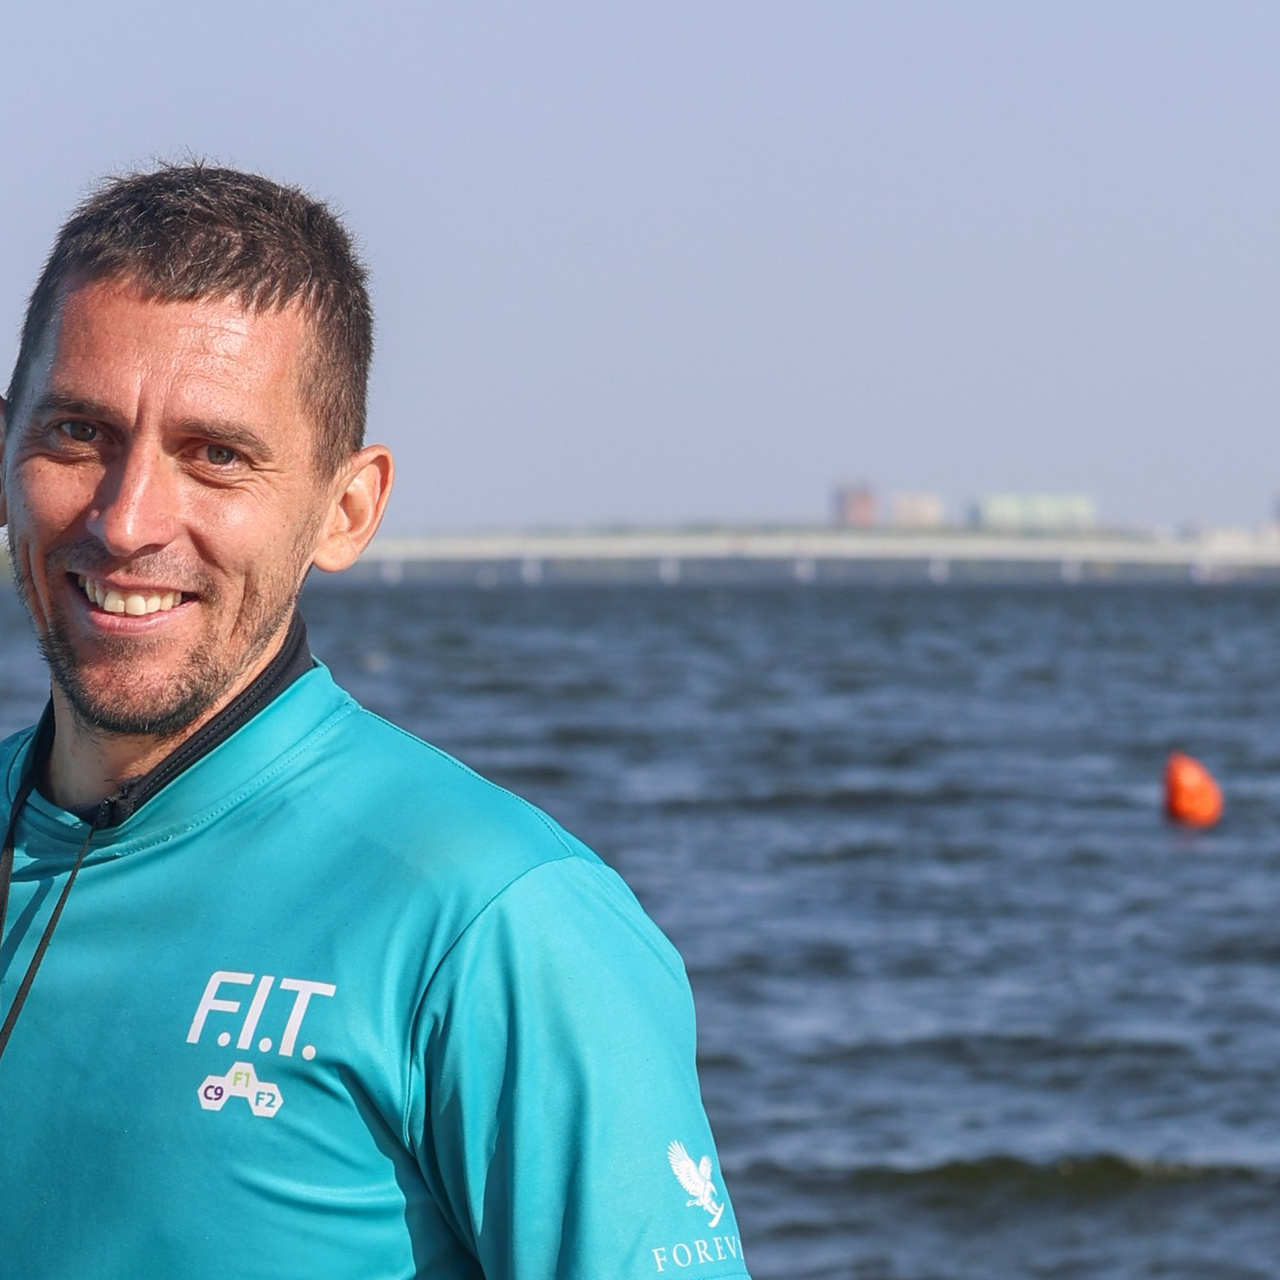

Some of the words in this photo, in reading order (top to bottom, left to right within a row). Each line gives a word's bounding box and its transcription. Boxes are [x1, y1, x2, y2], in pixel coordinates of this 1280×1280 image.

[185, 970, 337, 1061] F.I.T.
[232, 1070, 251, 1089] F1
[203, 1084, 224, 1101] C9
[254, 1090, 277, 1108] F2
